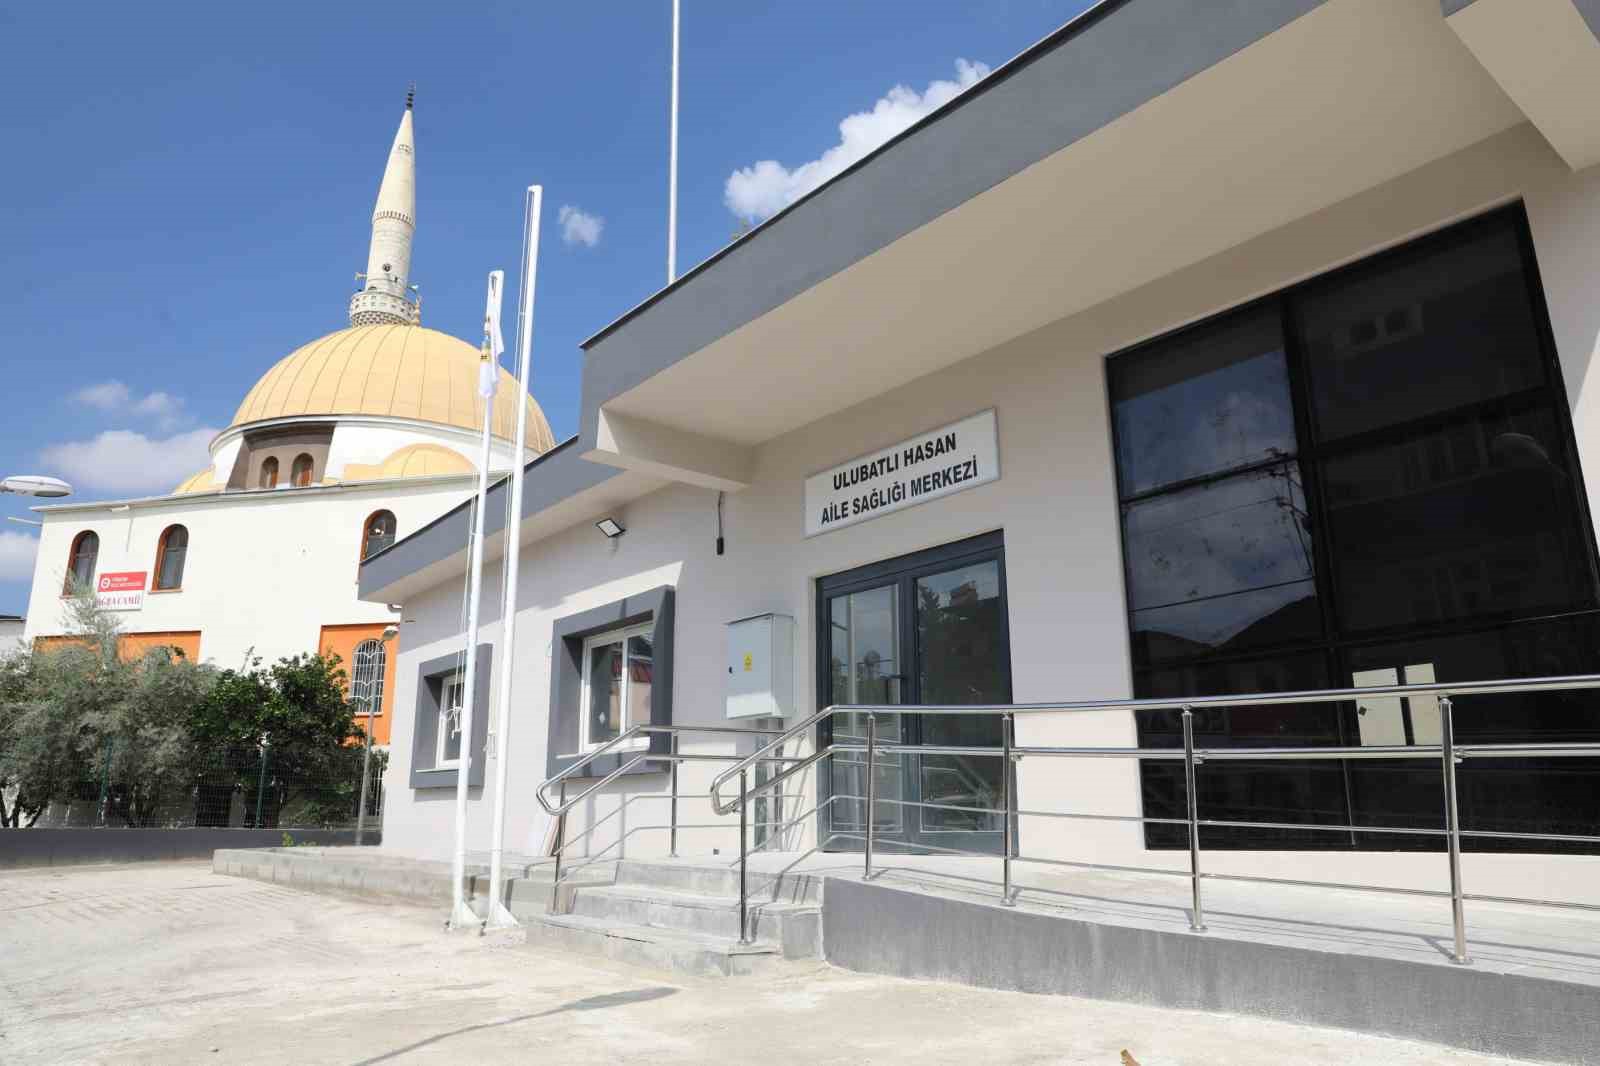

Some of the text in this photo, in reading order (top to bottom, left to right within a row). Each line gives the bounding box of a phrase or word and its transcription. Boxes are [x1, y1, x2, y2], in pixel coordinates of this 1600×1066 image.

[821, 455, 978, 525] AİLE SAĞLIĞI MERKEZİ
[833, 433, 956, 490] ULUBATLI HASAN
